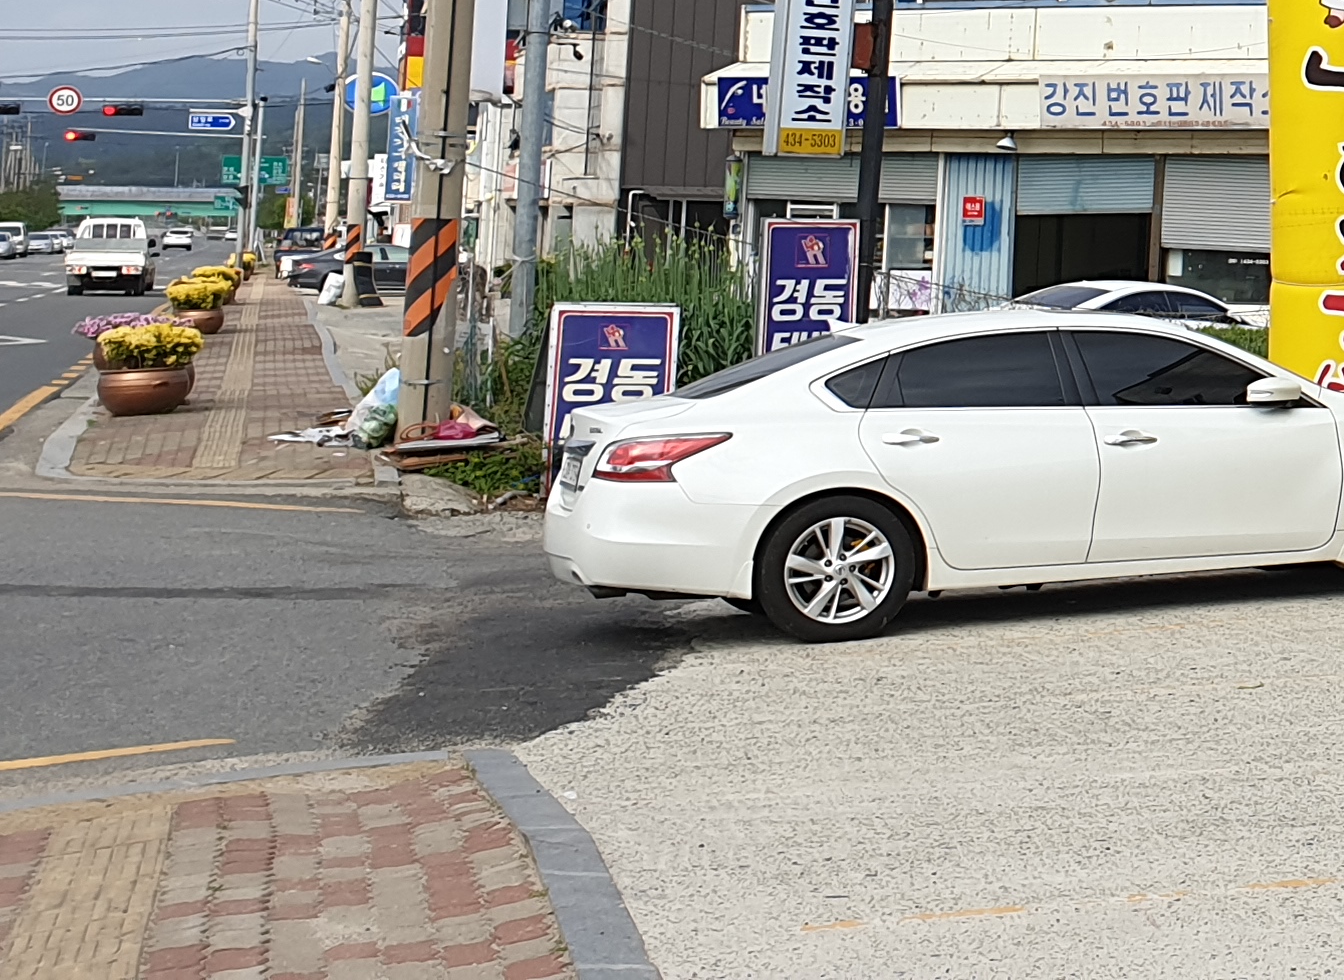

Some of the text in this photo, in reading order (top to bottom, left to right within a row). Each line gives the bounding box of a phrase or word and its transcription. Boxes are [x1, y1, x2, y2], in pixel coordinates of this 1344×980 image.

[56, 94, 74, 107] 50
[783, 132, 837, 148] 434-5303
[770, 278, 848, 322] 경동
[561, 357, 662, 403] 경동
